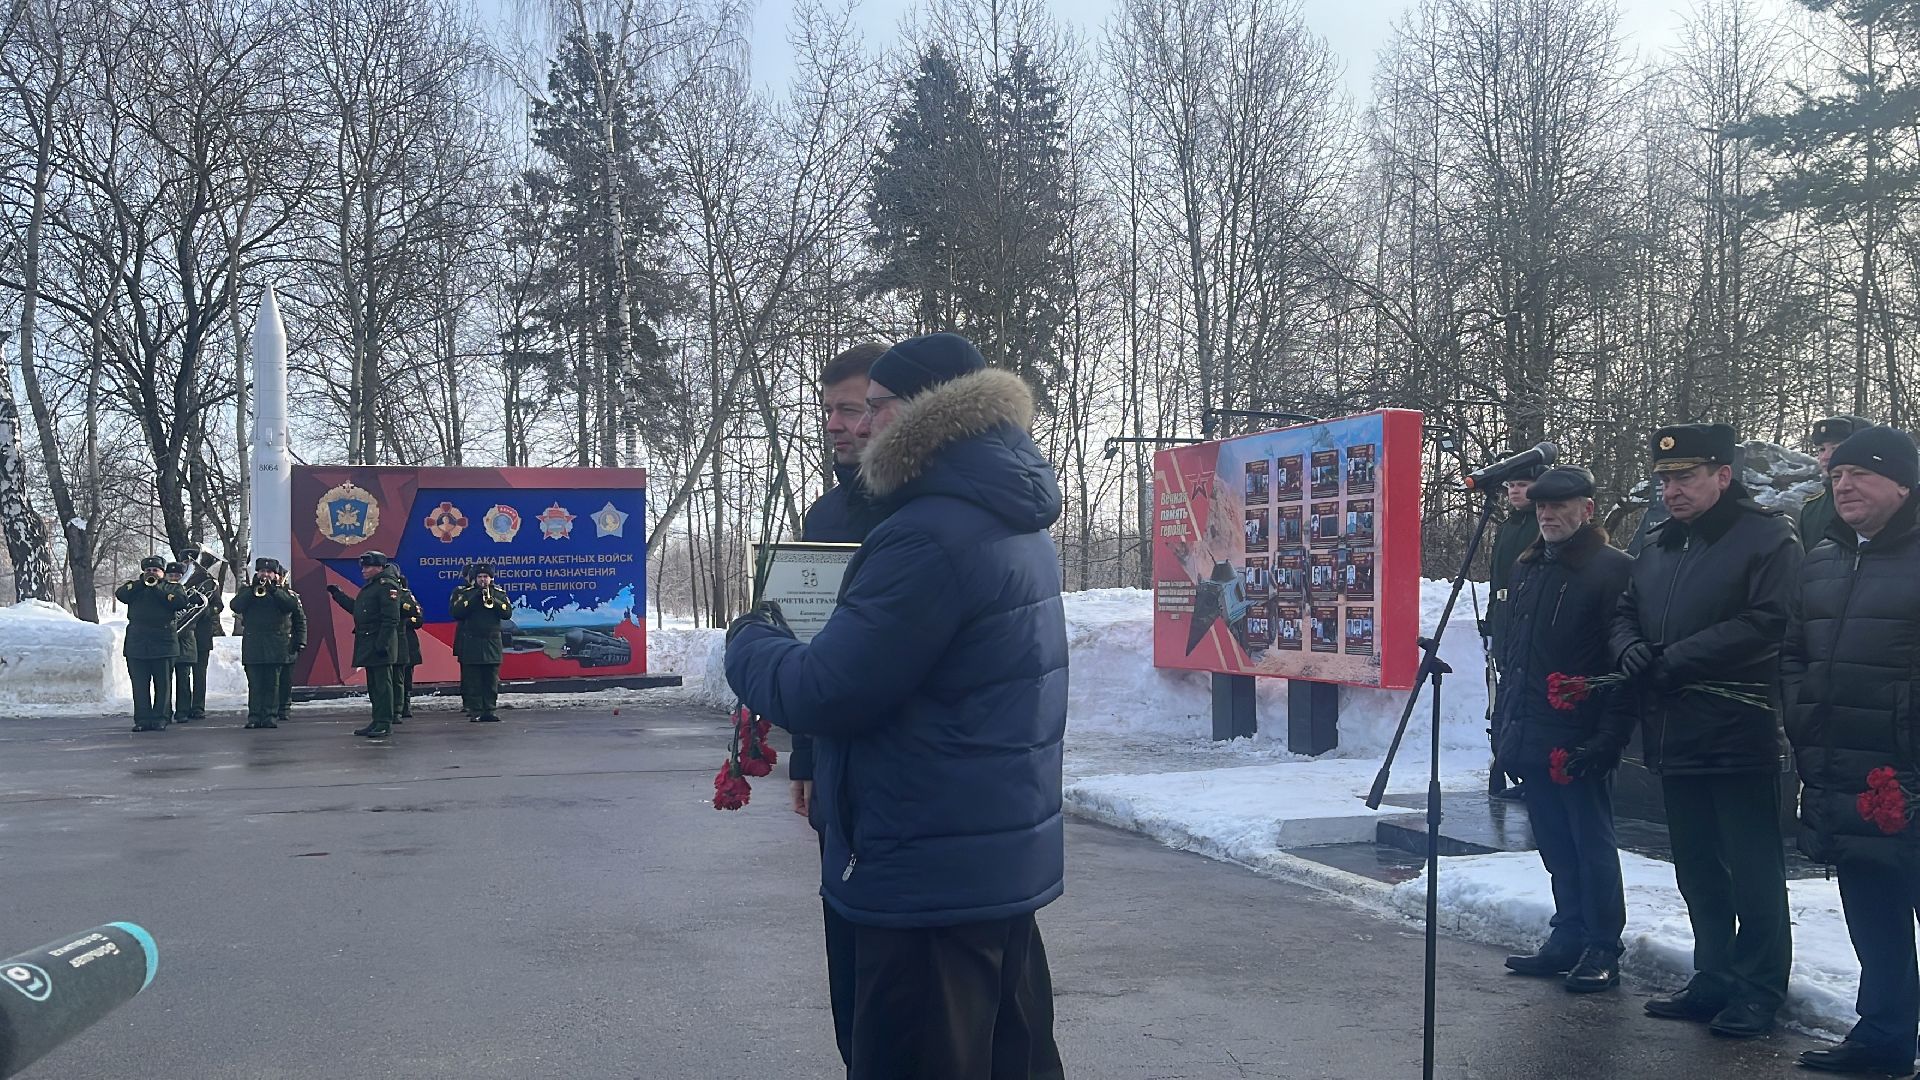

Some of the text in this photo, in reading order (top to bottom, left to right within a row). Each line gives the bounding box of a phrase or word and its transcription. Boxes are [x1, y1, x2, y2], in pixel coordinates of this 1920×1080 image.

[1160, 508, 1188, 521] память
[419, 552, 633, 566] ВОЕННАЯ АКАДЕМИЯ РАКЕТНЫХ ВОЙСК
[438, 567, 616, 579] СТРАЧЕСКОГО НАЗНАЧЕНИЯ
[503, 581, 597, 591] ПЕТРА ВЕЛИКОГО
